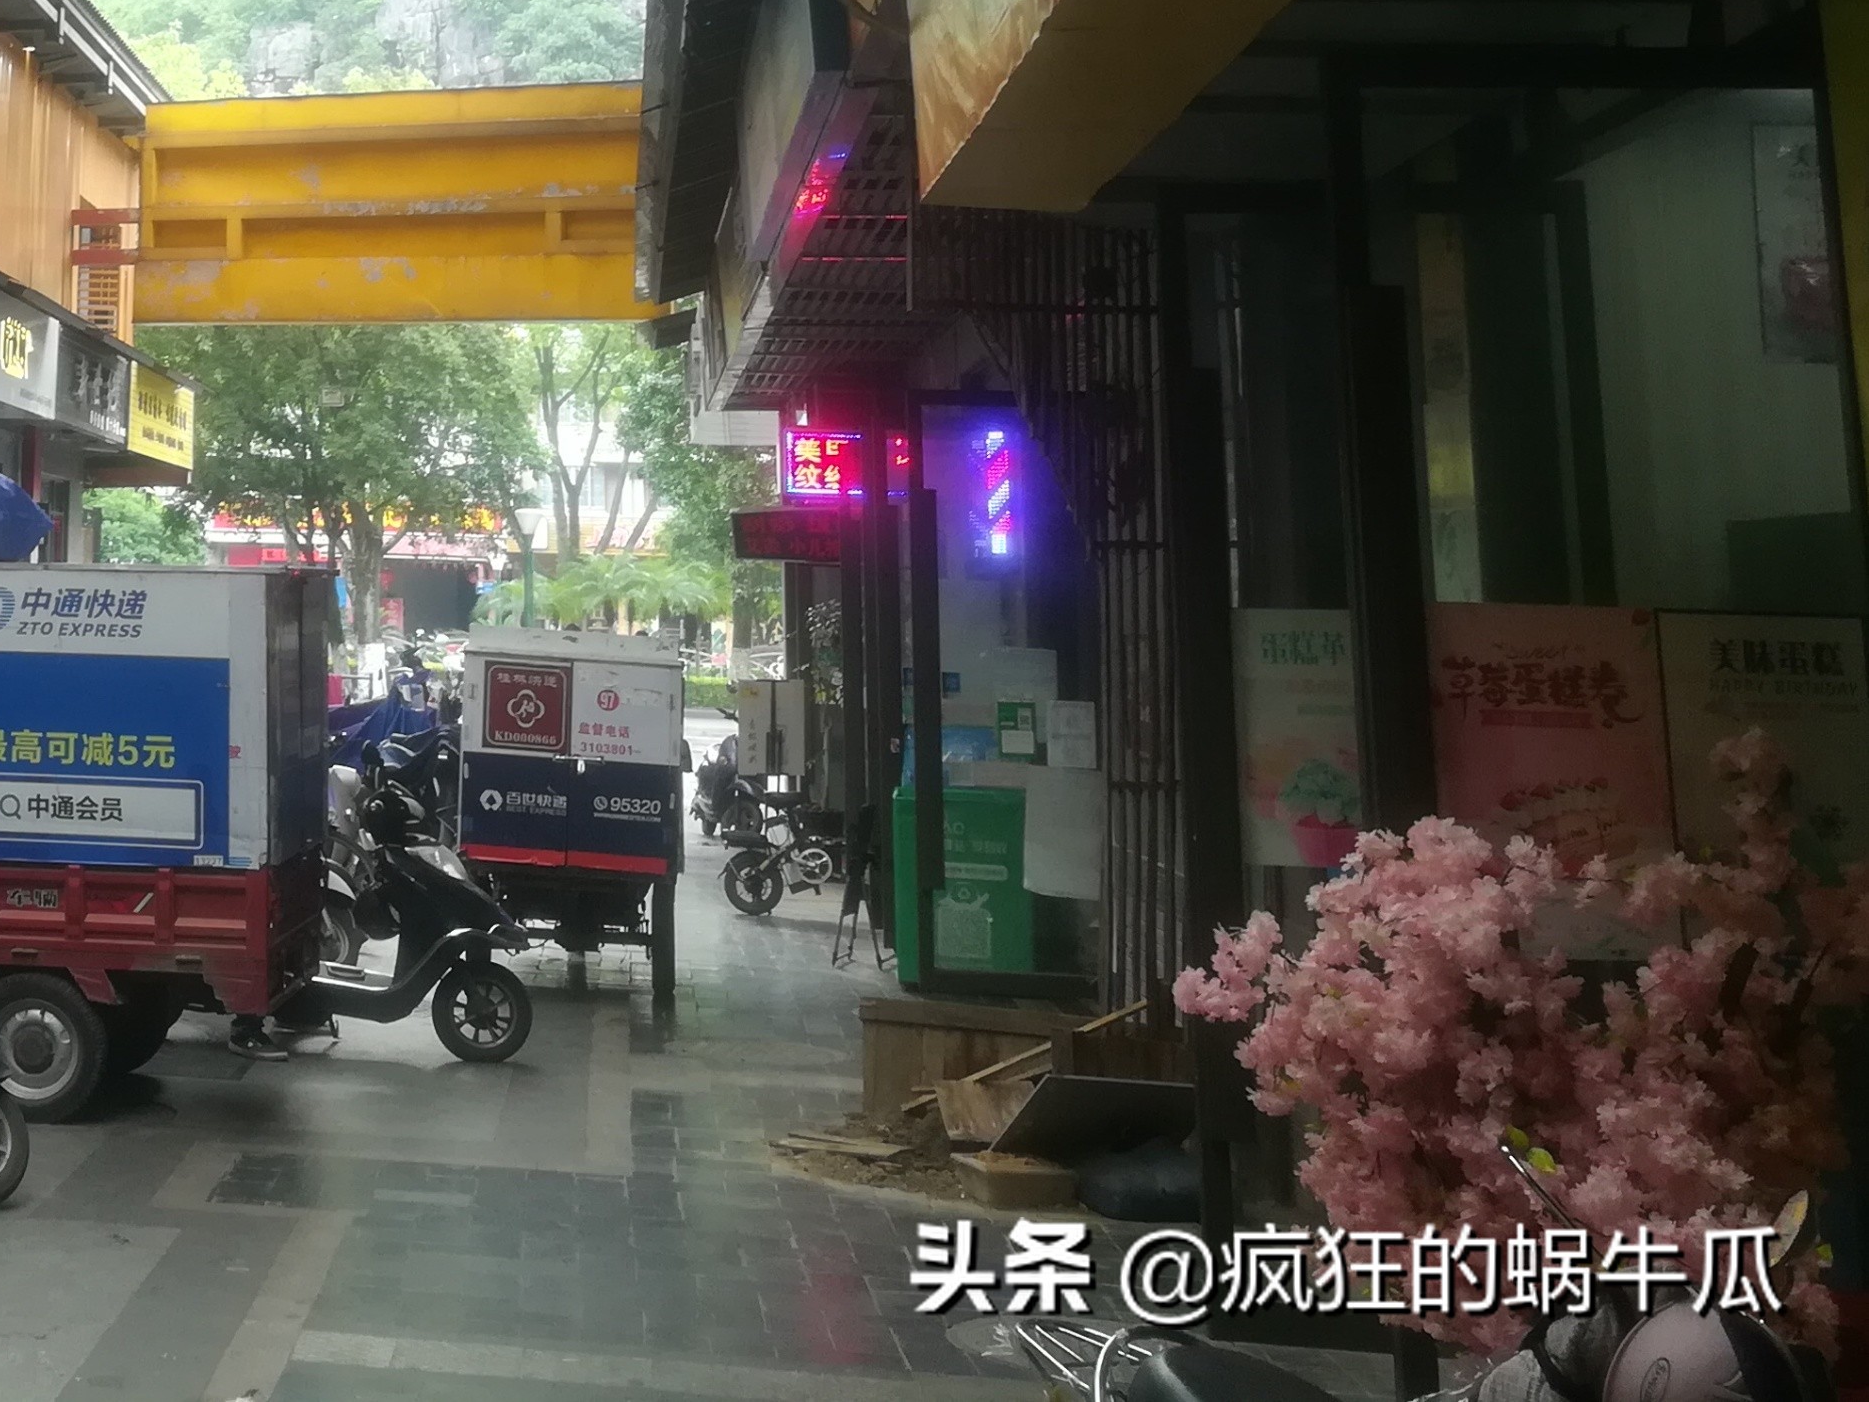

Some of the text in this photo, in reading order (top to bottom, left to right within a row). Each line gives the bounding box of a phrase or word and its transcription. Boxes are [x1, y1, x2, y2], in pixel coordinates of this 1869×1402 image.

[20, 588, 148, 622] 中通快递
[16, 621, 143, 639] ZTO EXPRESS
[578, 721, 630, 739] 监督电话
[27, 794, 124, 822] 中通会员
[506, 791, 568, 809] 百世快递
[610, 796, 662, 815] 95320
